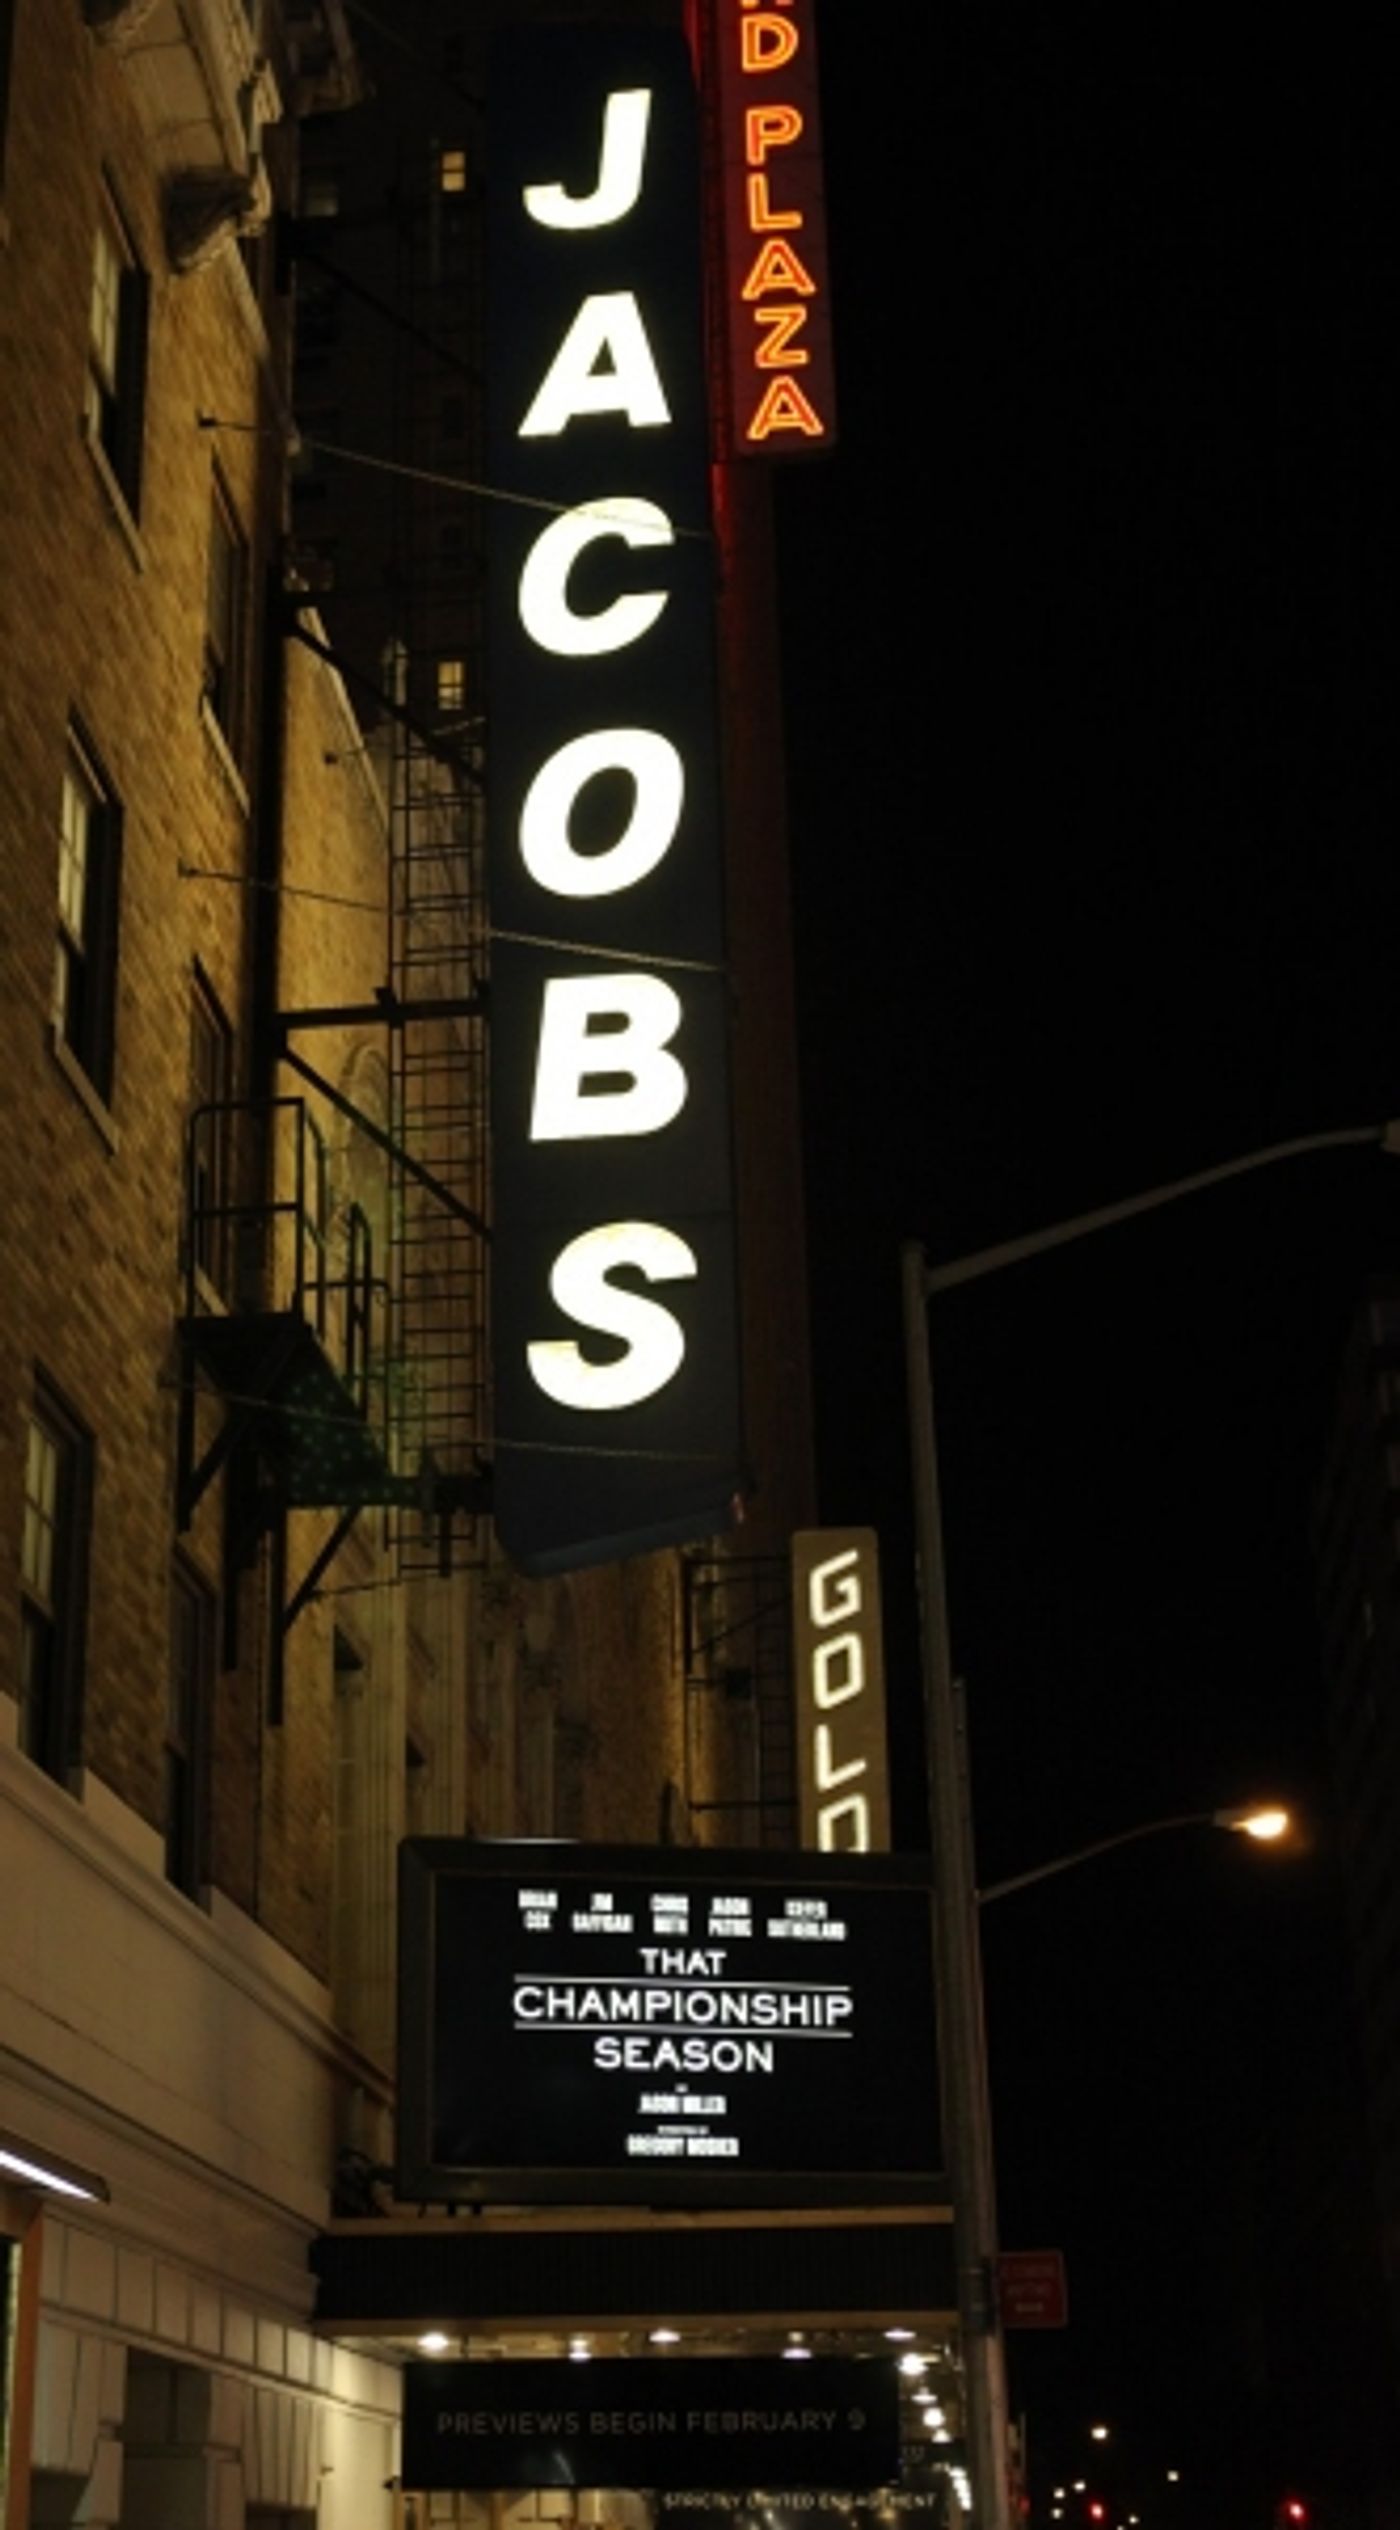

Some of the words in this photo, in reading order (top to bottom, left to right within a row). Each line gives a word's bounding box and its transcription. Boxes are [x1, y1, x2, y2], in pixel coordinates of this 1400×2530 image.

[741, 105, 824, 441] PLAZA
[517, 88, 698, 1411] JACOBS
[639, 1947, 728, 1976] THAT
[512, 1985, 854, 2027] CHAMPIONSHIP
[593, 2036, 775, 2073] SEASON
[437, 2411, 580, 2435] PREVIEWS
[589, 2411, 677, 2434] BEGIN
[686, 2409, 838, 2433] FEBRUARY
[849, 2407, 867, 2431] 9
